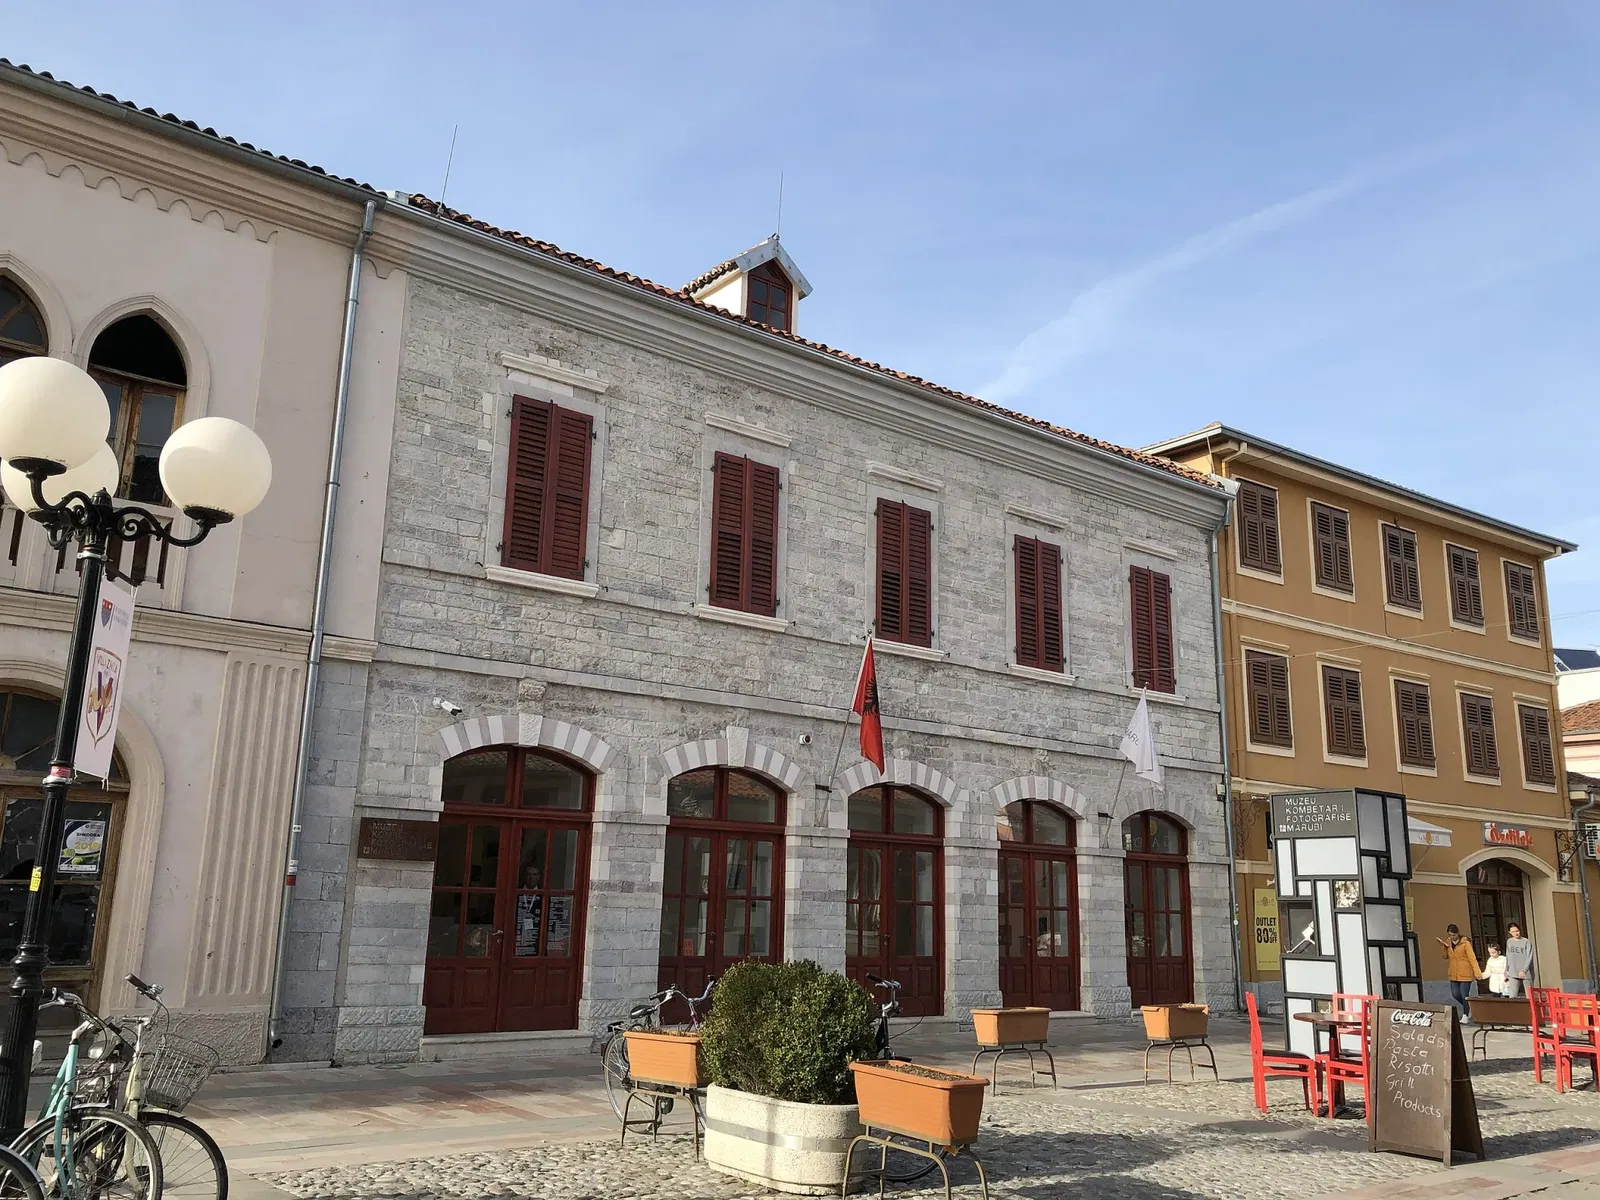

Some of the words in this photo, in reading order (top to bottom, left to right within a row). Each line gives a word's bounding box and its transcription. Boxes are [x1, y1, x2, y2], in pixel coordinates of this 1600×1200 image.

[1285, 797, 1317, 806] MUZEU
[1285, 805, 1338, 814] KOMBETAR
[1286, 813, 1351, 823] FOTOGRAFISE
[1286, 823, 1323, 832] MARUBI
[1256, 917, 1276, 926] OUTLET
[1391, 1009, 1432, 1027] Coca-Cola
[1385, 1074, 1415, 1091] Grill
[1393, 1091, 1441, 1118] Products
